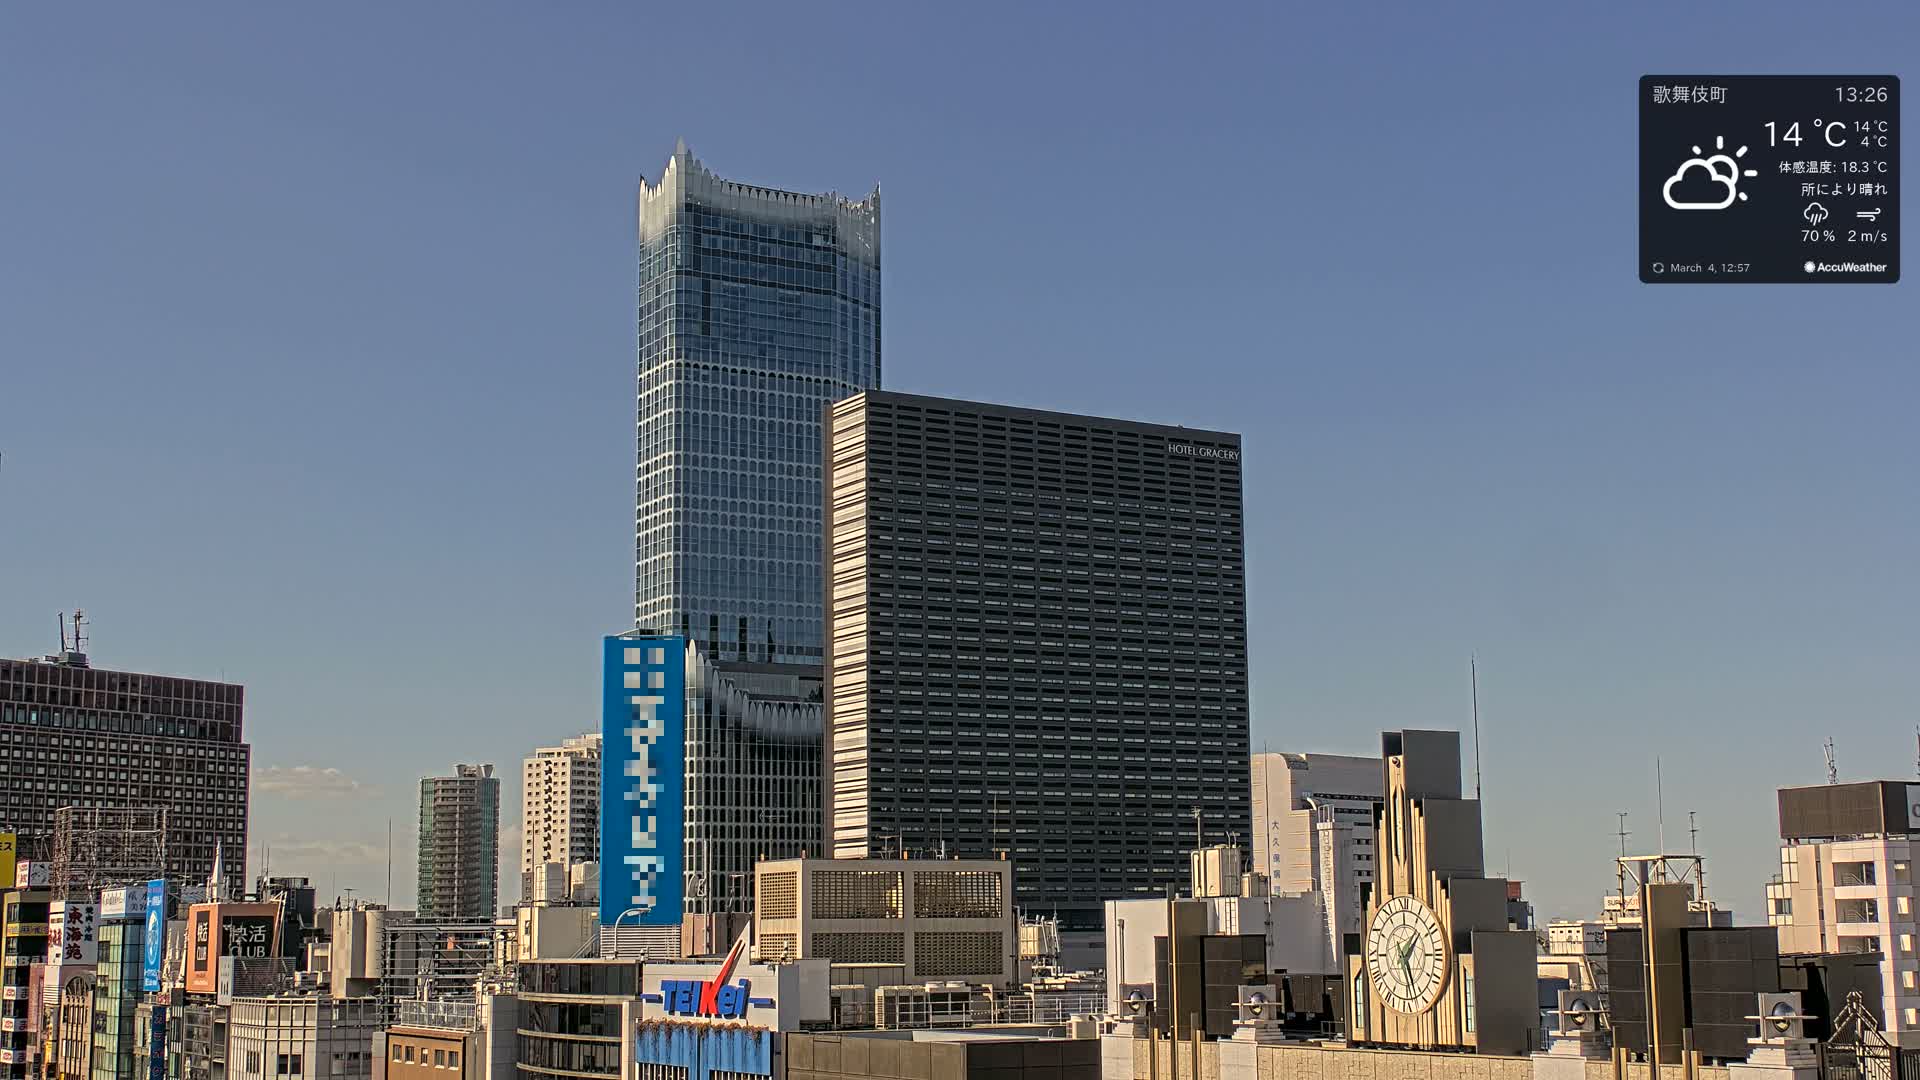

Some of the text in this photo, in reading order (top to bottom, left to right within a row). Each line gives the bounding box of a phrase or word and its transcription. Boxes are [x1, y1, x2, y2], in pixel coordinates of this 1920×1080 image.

[1168, 444, 1240, 460] HOTEL GRACERY
[230, 925, 267, 943] 快活
